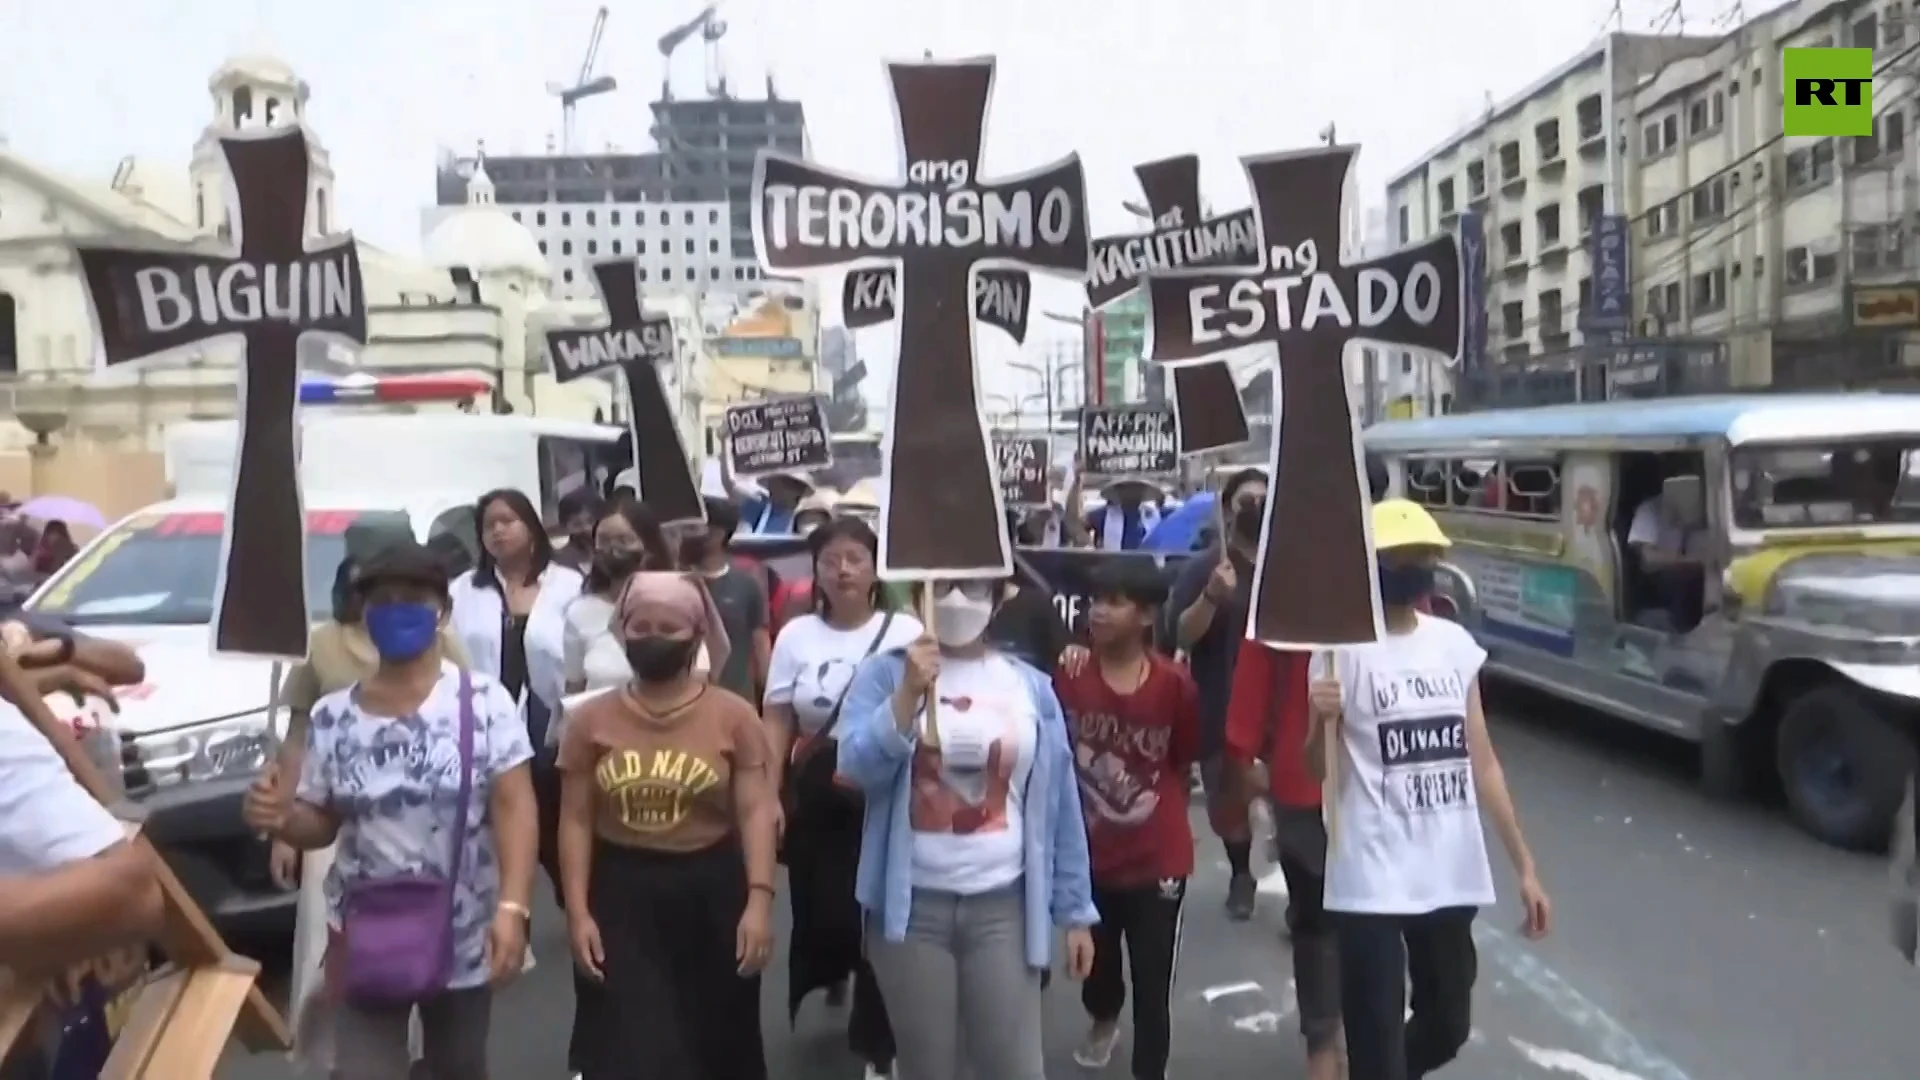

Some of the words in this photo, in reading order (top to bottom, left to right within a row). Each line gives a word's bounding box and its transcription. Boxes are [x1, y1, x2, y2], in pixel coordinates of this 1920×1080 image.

[909, 159, 969, 190] ang
[765, 184, 1071, 249] TERORISMO
[1271, 239, 1318, 276] ng
[135, 253, 350, 332] BIGUIN
[1189, 261, 1441, 345] ESTADO
[596, 750, 641, 793] OLD
[650, 750, 719, 795] NAVY
